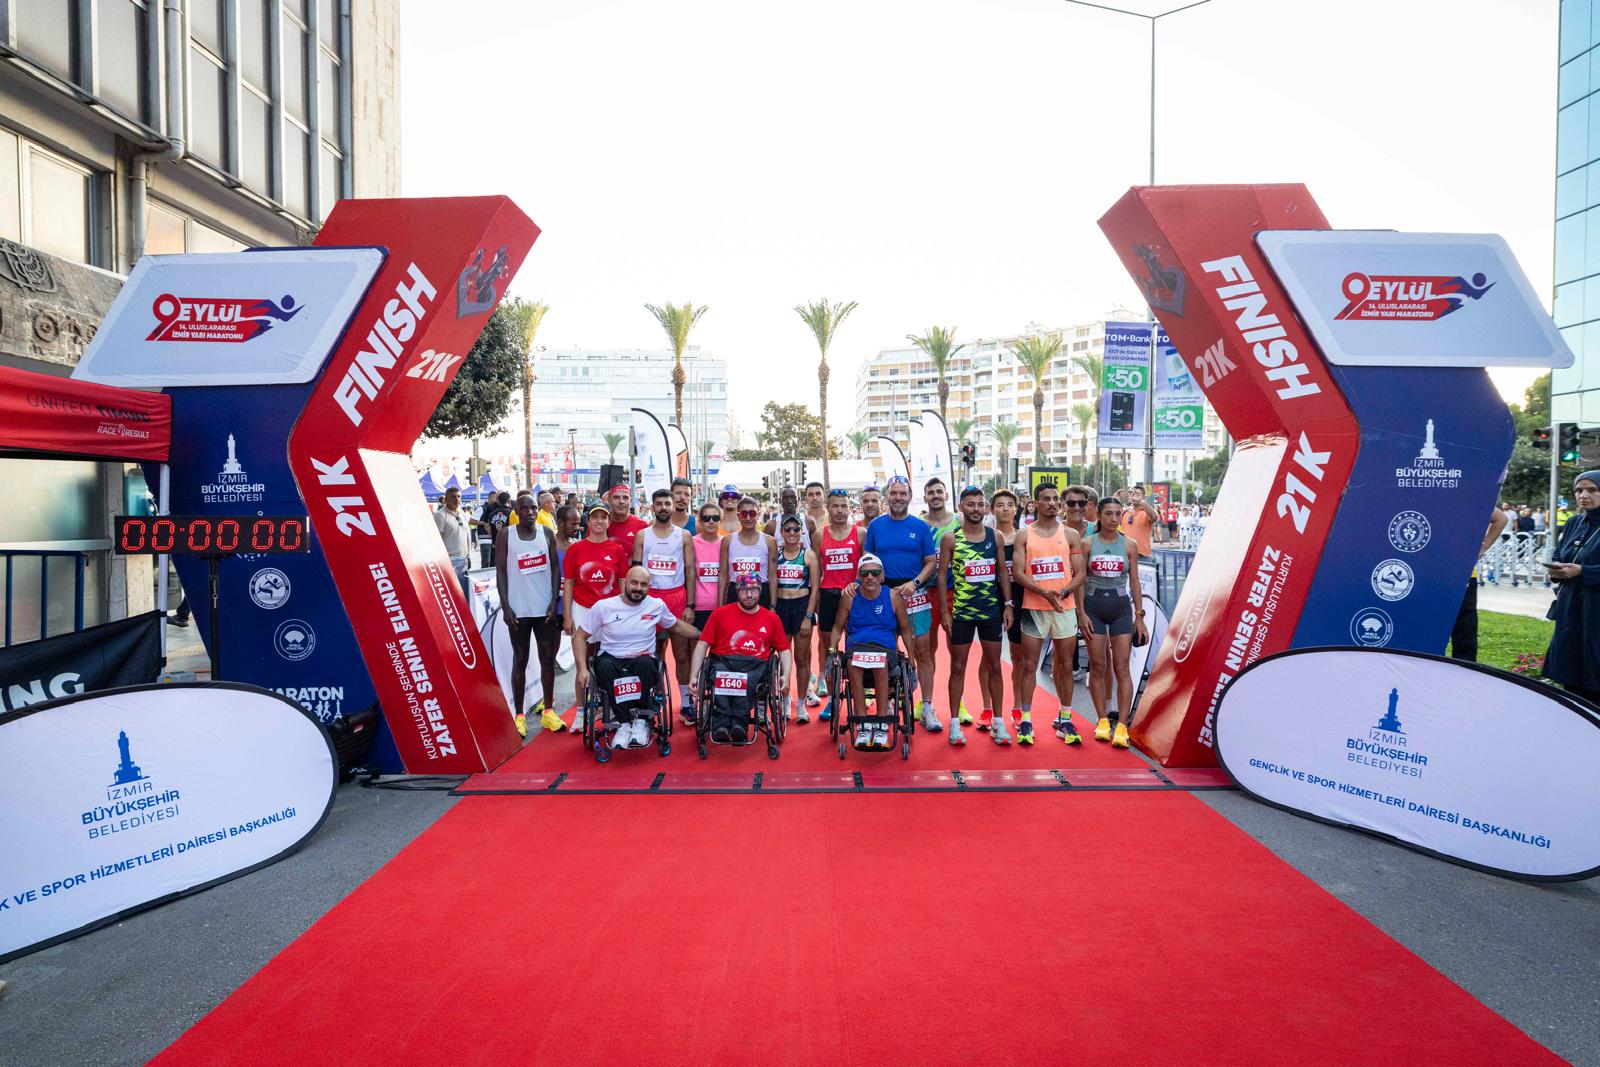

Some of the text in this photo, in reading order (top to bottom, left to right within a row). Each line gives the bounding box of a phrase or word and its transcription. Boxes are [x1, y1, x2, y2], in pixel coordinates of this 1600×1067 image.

[1367, 281, 1437, 301] EYLÜL
[179, 304, 244, 321] EYLÜL
[1361, 309, 1380, 317] İZMİR
[1381, 310, 1396, 318] YARI
[172, 330, 243, 340] İZMİR YARI MARATONU
[1200, 255, 1322, 400] FINISH
[333, 262, 437, 427] FINISH
[406, 349, 461, 383] 21K
[1195, 338, 1237, 389] 21K
[1107, 369, 1143, 389] %50
[27, 393, 91, 415] UNITED
[1157, 410, 1196, 429] %50
[97, 424, 150, 439] RACE RESULT
[1414, 457, 1444, 468] İZMİR
[218, 473, 248, 484] İZMİR
[1396, 467, 1462, 480] BÜYÜKŞEHİR
[1398, 477, 1459, 488] BELEDİYESİ
[201, 482, 265, 495] BÜYÜKŞEHİR
[204, 493, 262, 503] BELEDİYESİ
[652, 560, 672, 569] 2117
[736, 562, 756, 571] 2400
[830, 554, 849, 563] 2345
[1097, 561, 1119, 570] 2402
[703, 567, 720, 576] 239
[780, 569, 799, 578] 1206
[970, 565, 991, 576] 3059
[1036, 563, 1059, 573] 1778
[1246, 544, 1281, 607] ZAFER
[1261, 554, 1293, 625] KURTULUŞUN
[1224, 608, 1258, 672] SENİN
[368, 563, 457, 758] ZAFER SENİN ELİNDE!
[617, 683, 637, 695] 1289
[719, 678, 742, 689] 1640
[386, 642, 438, 760] KURTULUŞUN ŞEHRİNDE
[1369, 729, 1407, 747] İZMİR
[1346, 738, 1428, 766] BÜYÜKŞEHİR
[1347, 752, 1423, 779] BELEDİYESİ
[107, 781, 153, 802] İZMİR
[81, 789, 180, 825] BÜYÜKŞEHİR
[1249, 758, 1551, 849] GENÇLİK VE SPOR HİZMETLERİ DAİRESİ BAŞKANLIĞI
[88, 803, 180, 840] BELEDİYESİ
[13, 889, 37, 905] VE
[41, 873, 87, 897] SPOR
[90, 844, 175, 881] HİZMETLERİ
[177, 828, 228, 854] DAİRESİ
[229, 807, 297, 838] BAŞKANLIĞI
